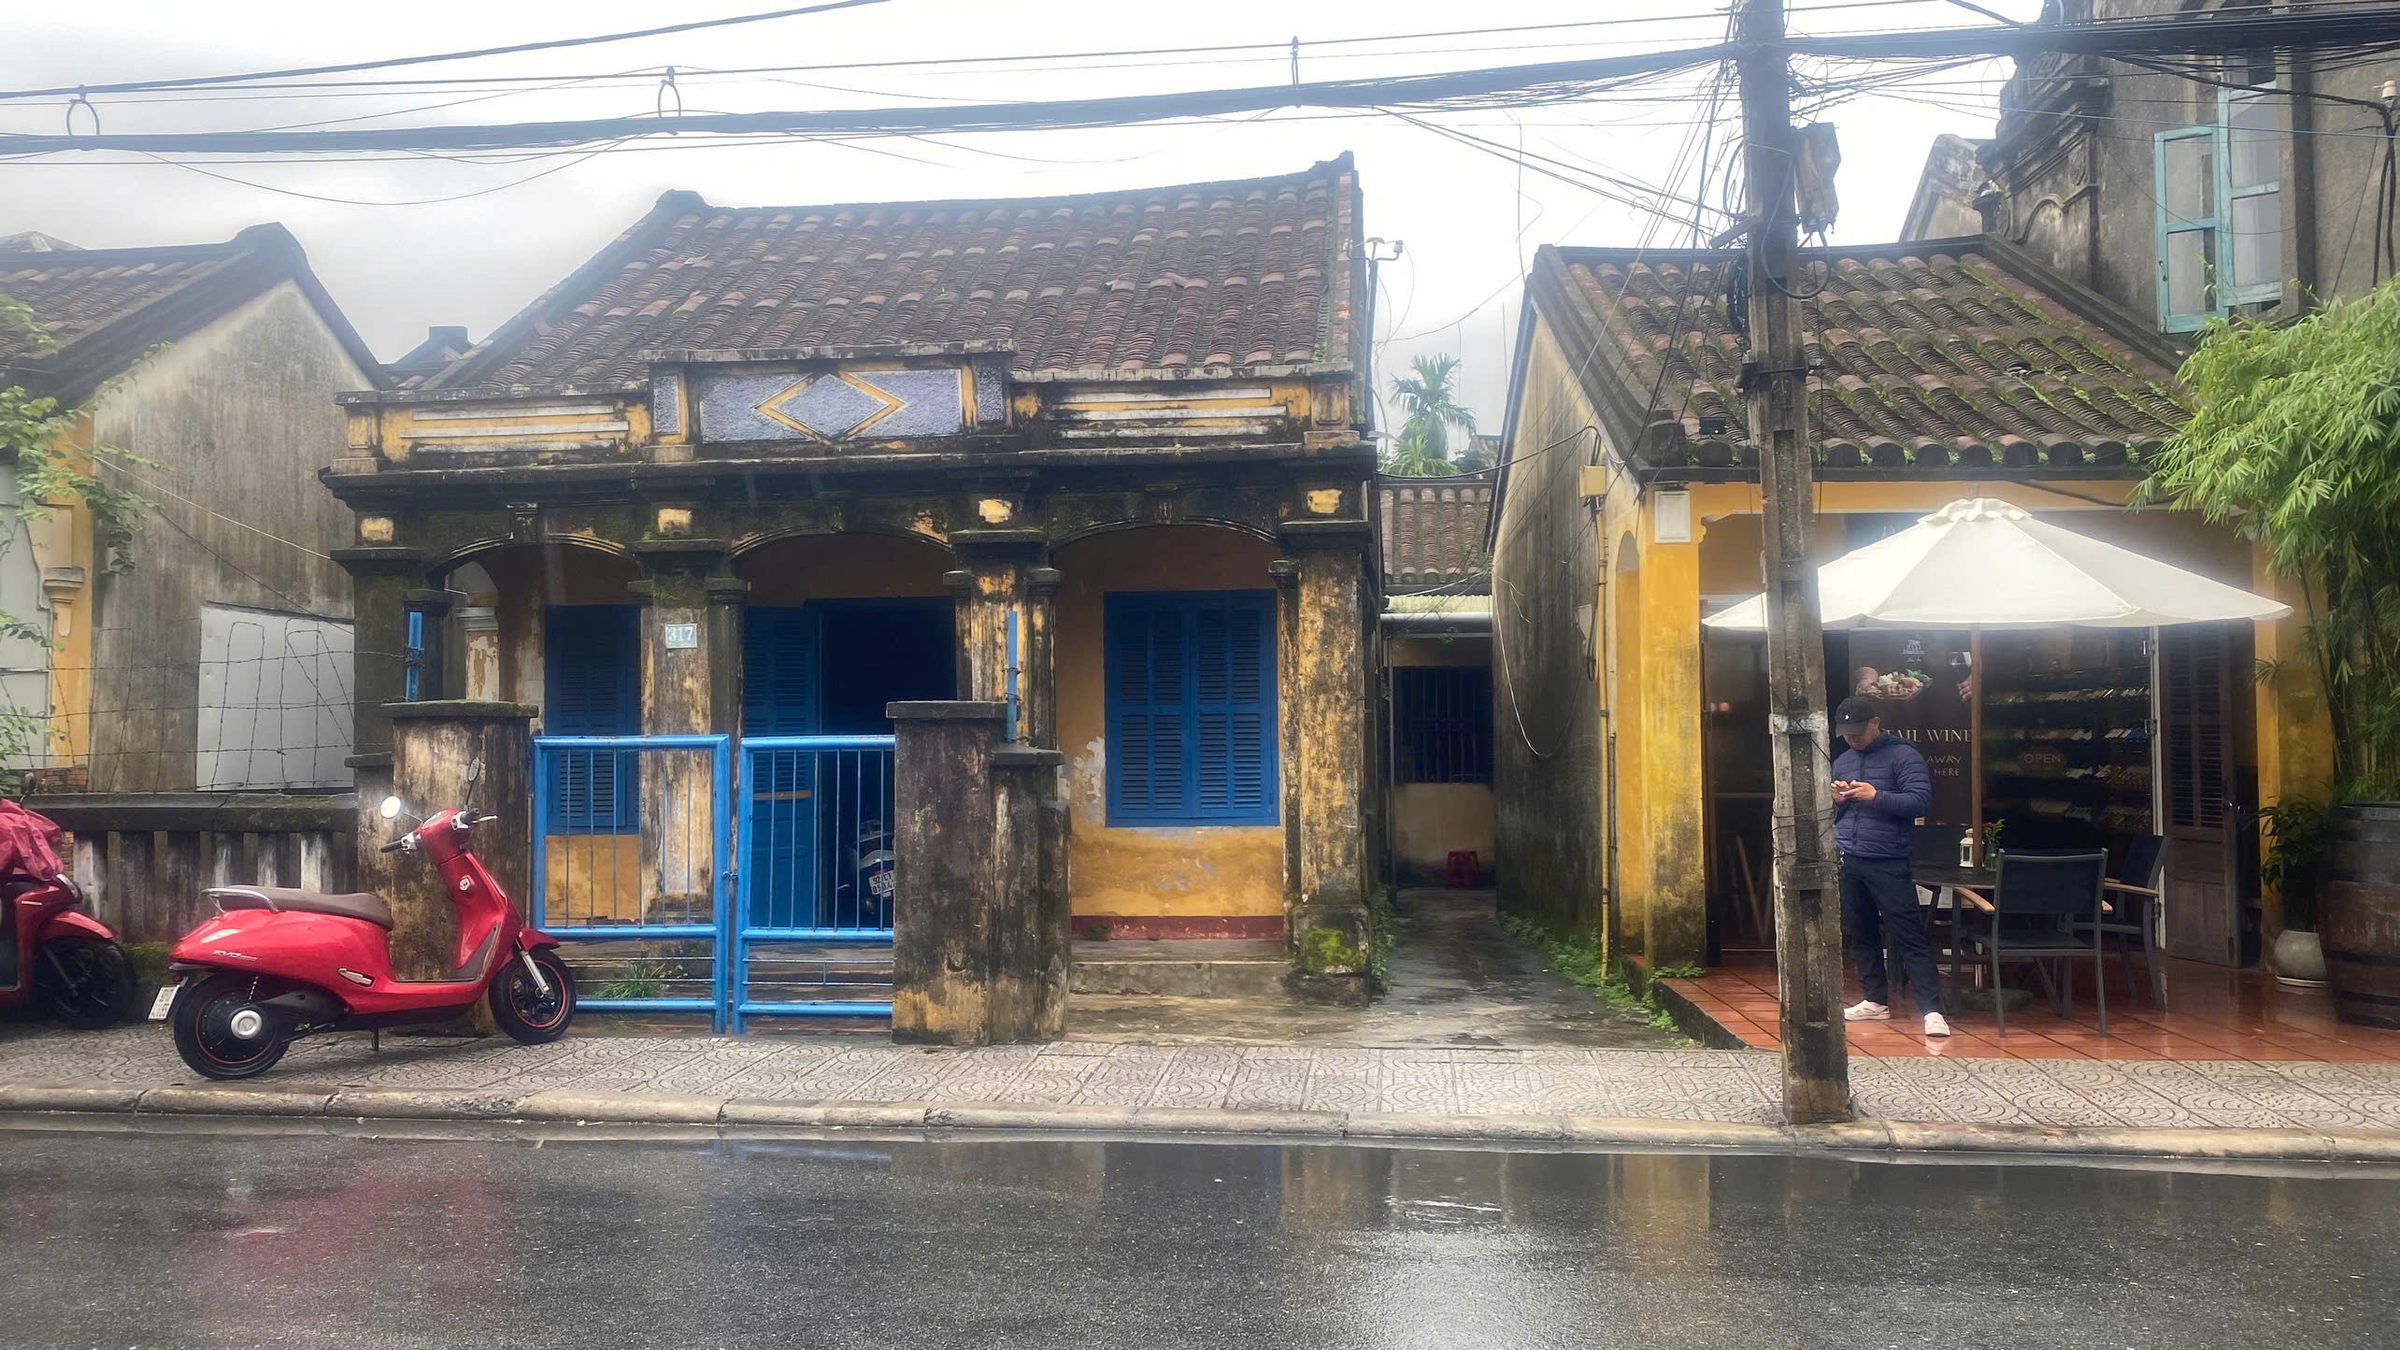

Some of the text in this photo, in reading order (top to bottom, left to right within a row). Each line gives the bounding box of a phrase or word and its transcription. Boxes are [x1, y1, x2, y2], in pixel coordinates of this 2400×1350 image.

[668, 626, 693, 642] 317
[1927, 755, 1962, 764] AWAY
[2023, 753, 2062, 764] OPEN
[1934, 767, 1960, 777] HERE
